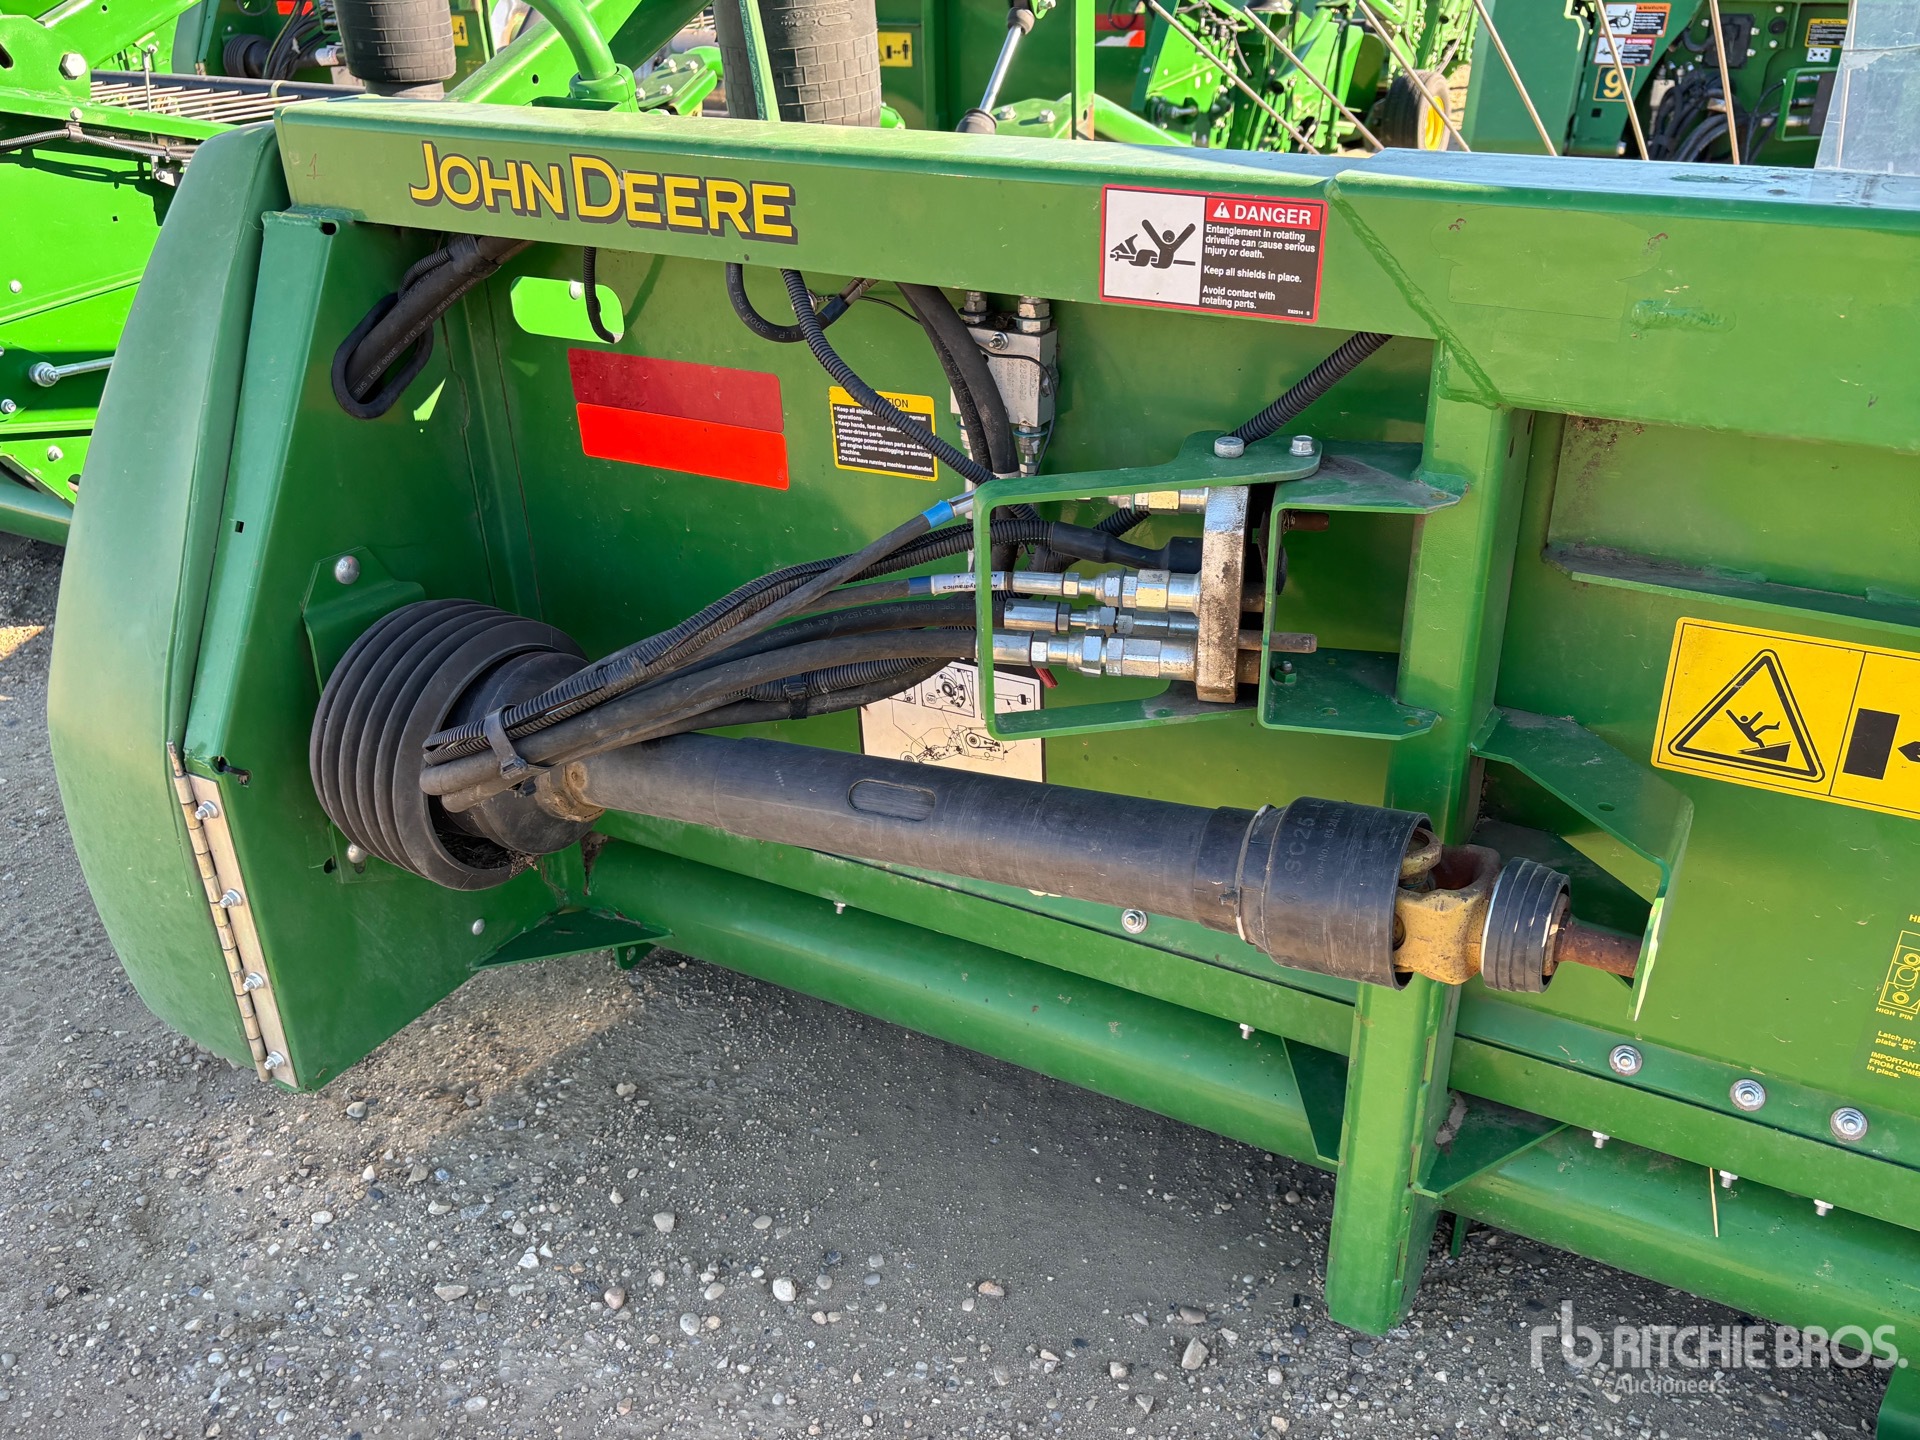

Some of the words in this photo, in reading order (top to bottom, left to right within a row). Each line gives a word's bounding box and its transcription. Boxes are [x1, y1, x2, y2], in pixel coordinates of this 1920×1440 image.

[408, 141, 569, 220] JOHN
[569, 153, 798, 246] DEERE
[1234, 204, 1312, 226] DANGER
[1205, 224, 1262, 238] Entanglement
[1263, 229, 1271, 238] in
[1273, 230, 1306, 243] rotating
[1205, 235, 1240, 246] driveline
[1241, 239, 1256, 247] can
[1257, 240, 1283, 250] cause
[1284, 243, 1316, 253] serious
[1204, 245, 1228, 257] injury
[1229, 249, 1238, 257] or
[1240, 249, 1265, 259] death.
[1203, 265, 1224, 277] Keep
[1225, 267, 1236, 277] all
[1236, 268, 1266, 280] shields
[1268, 271, 1276, 280] in
[1277, 272, 1302, 283] place.
[733, 290, 747, 310] PSI
[1202, 285, 1226, 296] Avoid
[1227, 288, 1257, 299] contact
[1258, 291, 1276, 301] with
[1201, 296, 1233, 308] rotating
[1234, 299, 1257, 309] parts.
[745, 312, 768, 333] 3000
[381, 347, 399, 365] 3000
[367, 365, 382, 380] PSI
[836, 406, 849, 414] Keep
[837, 420, 850, 428] Keep
[838, 427, 869, 437] power-driven
[839, 434, 864, 444] Disengage
[863, 438, 894, 447] power-driven
[893, 441, 907, 449] parts
[847, 442, 863, 451] engine
[878, 446, 905, 457] unclogging
[910, 450, 933, 460] servicing
[868, 458, 887, 468] running
[886, 461, 907, 469] machine
[1875, 1006, 1896, 1016] HIGH
[1899, 1012, 1914, 1021] PIN
[1875, 1037, 1897, 1047] plate
[1877, 1030, 1902, 1042] Latch
[1902, 1038, 1917, 1046] pin
[1869, 1057, 1895, 1070] FROM
[1876, 1068, 1901, 1079] place.
